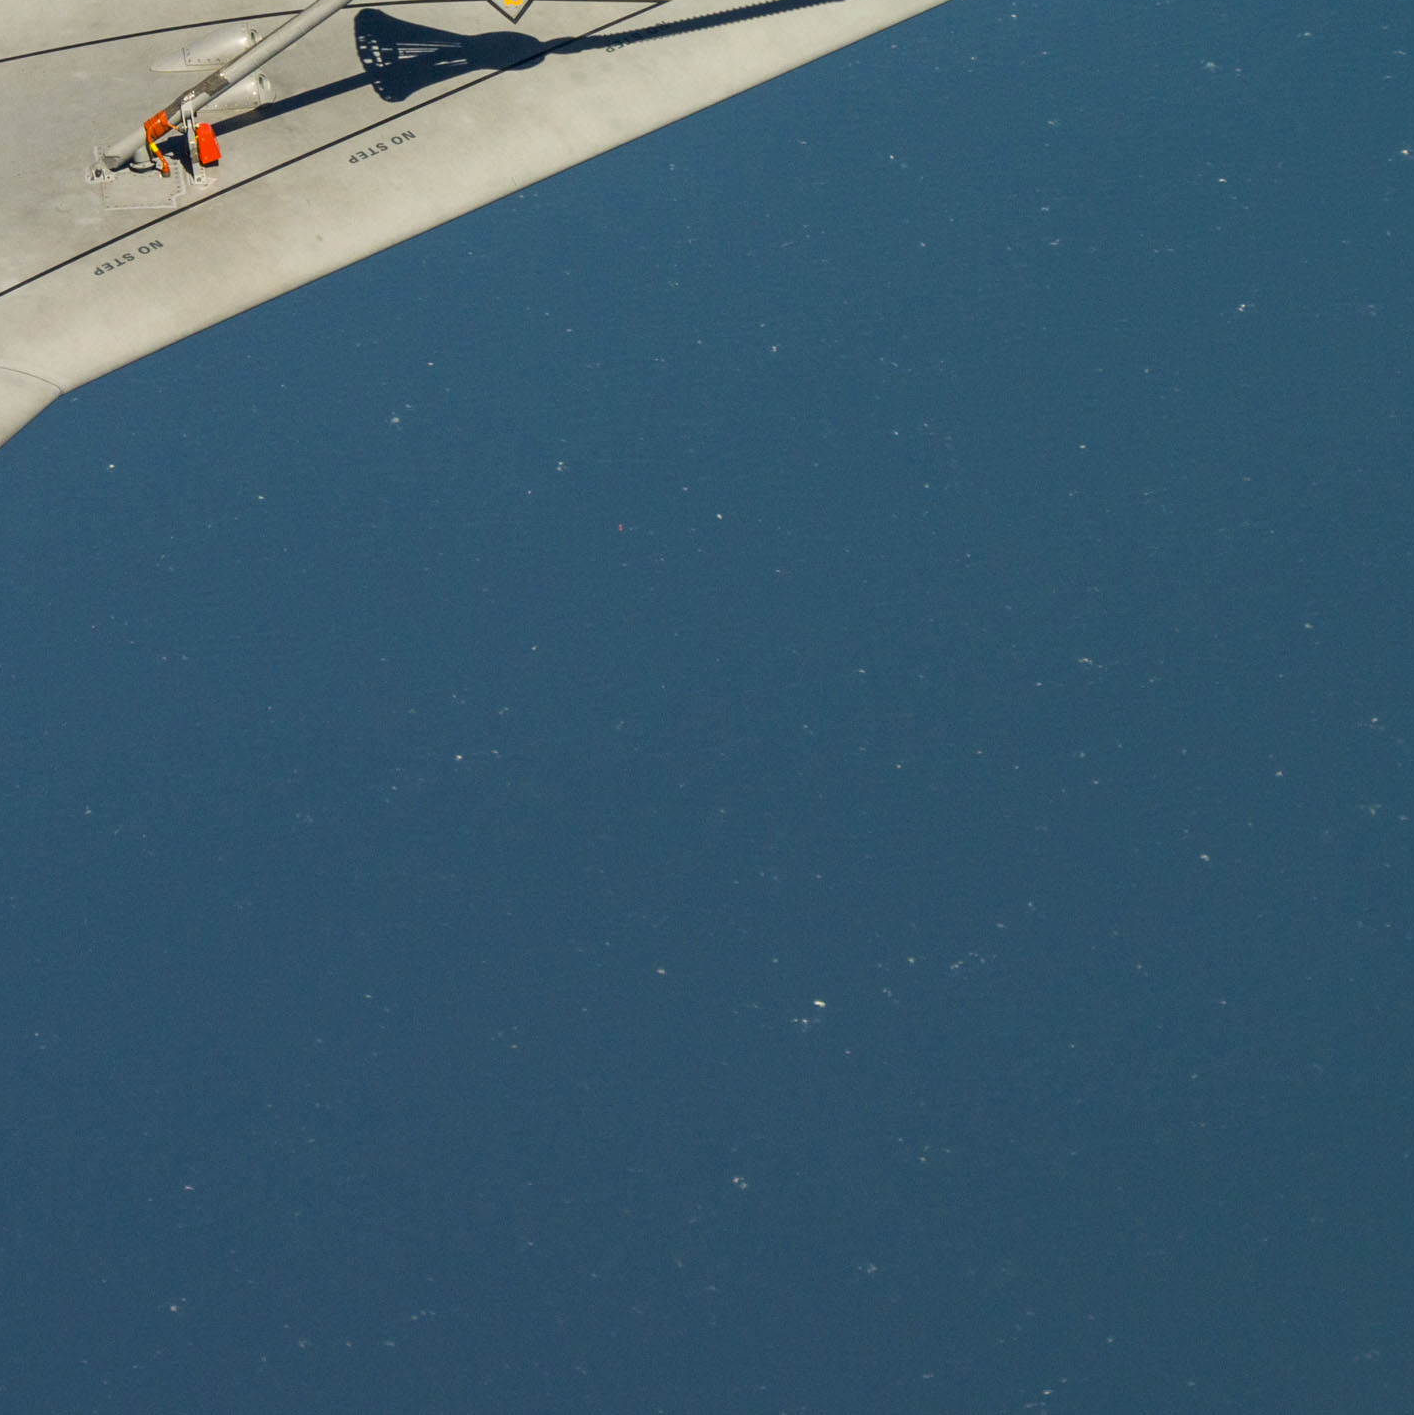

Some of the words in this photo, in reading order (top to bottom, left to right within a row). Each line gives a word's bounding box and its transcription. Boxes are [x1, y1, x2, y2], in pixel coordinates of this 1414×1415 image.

[390, 130, 417, 145] NO
[348, 142, 389, 164] STEP
[137, 239, 164, 255] NO
[94, 252, 136, 276] STEP
